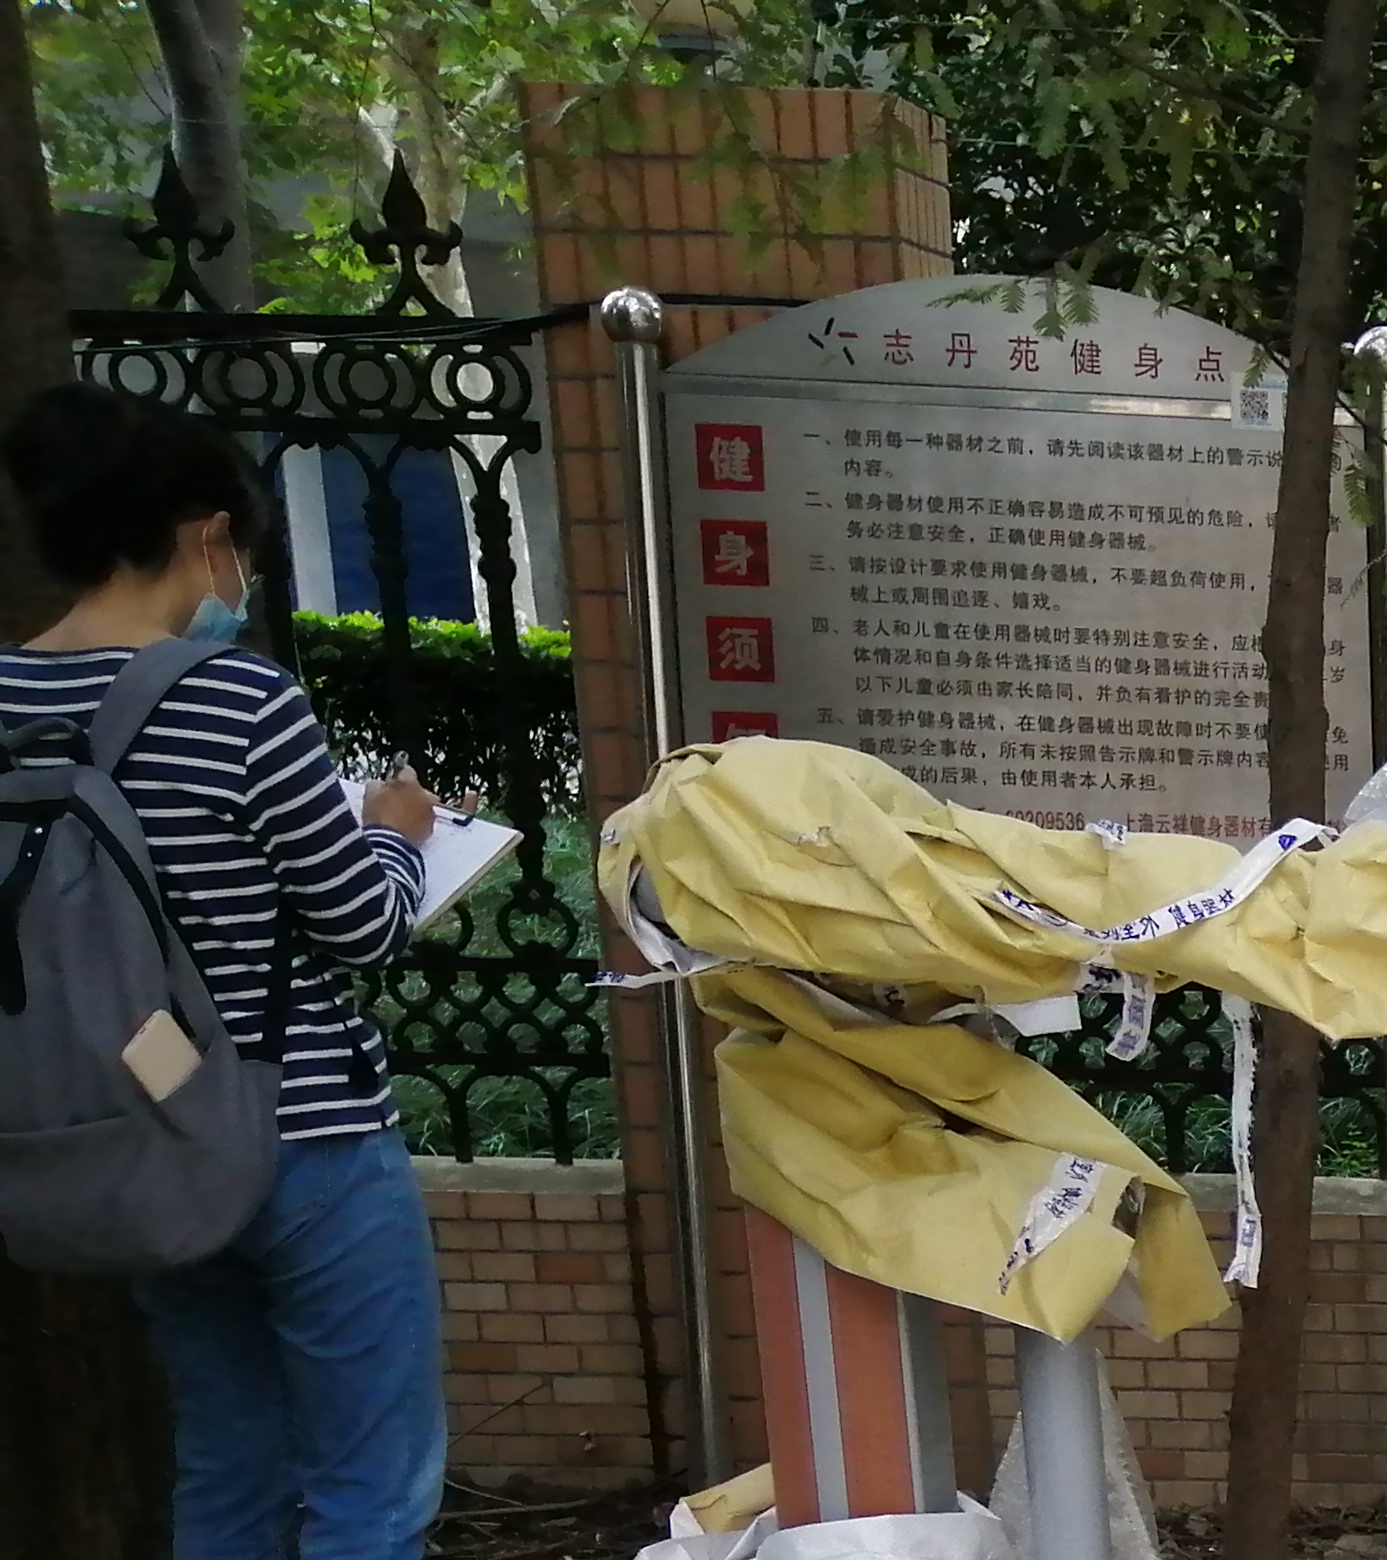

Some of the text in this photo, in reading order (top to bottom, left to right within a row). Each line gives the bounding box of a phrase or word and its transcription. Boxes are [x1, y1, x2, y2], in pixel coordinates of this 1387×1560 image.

[883, 328, 1225, 383] 志丹苑健身点
[844, 459, 894, 479] 内容。
[846, 520, 1156, 552] 务必注意安全，正确使用健身器械。
[851, 585, 1062, 612] 械上或周围追逐、嬉戏。
